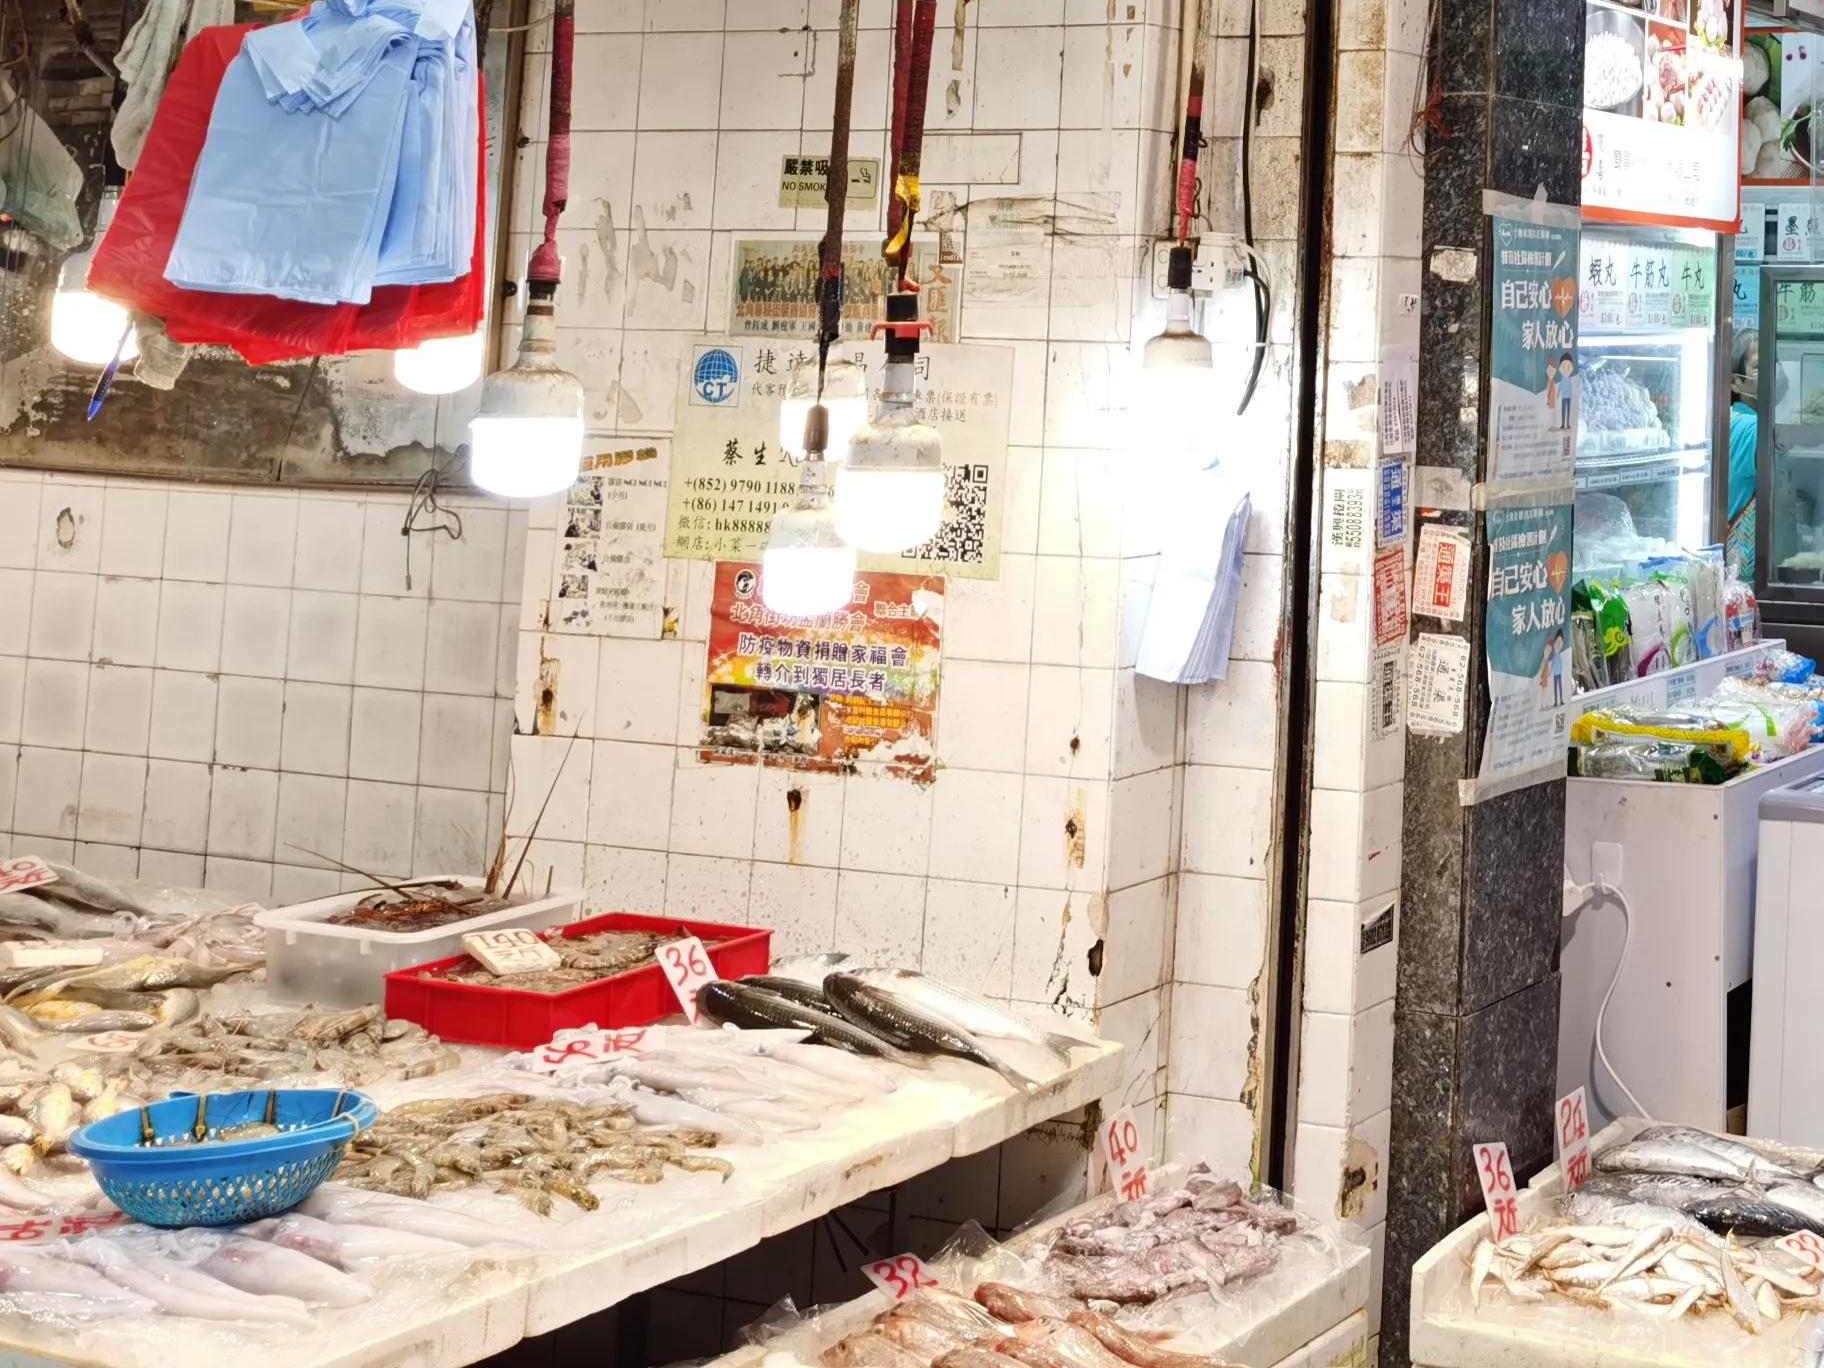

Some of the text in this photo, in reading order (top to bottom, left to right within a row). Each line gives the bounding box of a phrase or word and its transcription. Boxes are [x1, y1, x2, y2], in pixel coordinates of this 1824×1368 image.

[784, 158, 832, 175] 嚴禁吸
[781, 181, 828, 192] NO SMOK
[1681, 260, 1705, 292] 牛丸
[1501, 279, 1552, 310] 自己安心
[1522, 320, 1575, 350] 家人放心
[703, 381, 727, 397] CT
[730, 480, 762, 495] 9790
[721, 499, 744, 513] 147
[1433, 542, 1456, 608] 通渠王
[1491, 559, 1548, 599] 自己安心
[1512, 595, 1566, 635] 家人放心
[739, 634, 907, 667] 防疫物資捐贈家福會
[756, 663, 887, 693] 轉介到獨居長者
[664, 943, 708, 987] 36
[1561, 1095, 1585, 1149] 24
[1108, 1120, 1137, 1167] 40
[1480, 1146, 1511, 1194] 36
[872, 1255, 938, 1299] 32
